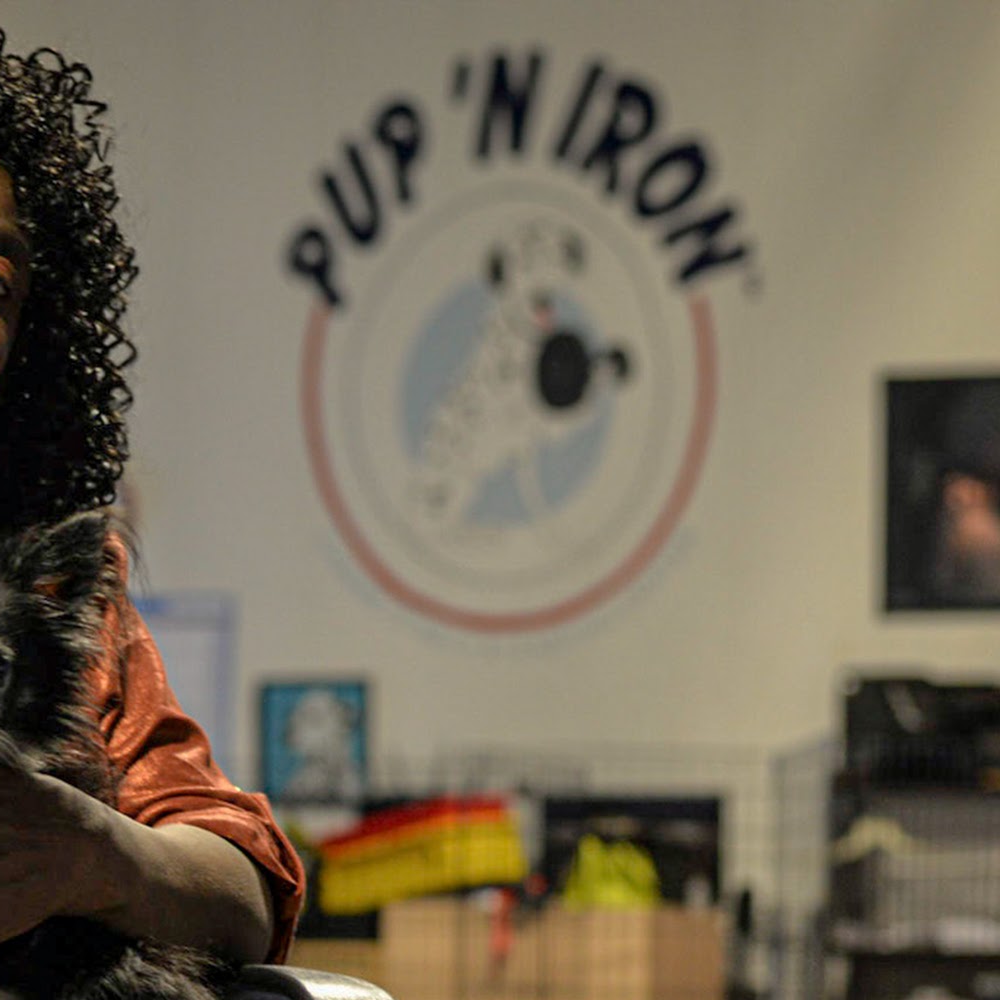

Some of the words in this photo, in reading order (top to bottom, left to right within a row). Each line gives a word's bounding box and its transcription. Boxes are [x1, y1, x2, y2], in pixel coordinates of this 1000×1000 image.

[285, 98, 425, 310] PUP
[452, 49, 545, 161] 'N
[552, 60, 750, 285] IRON
